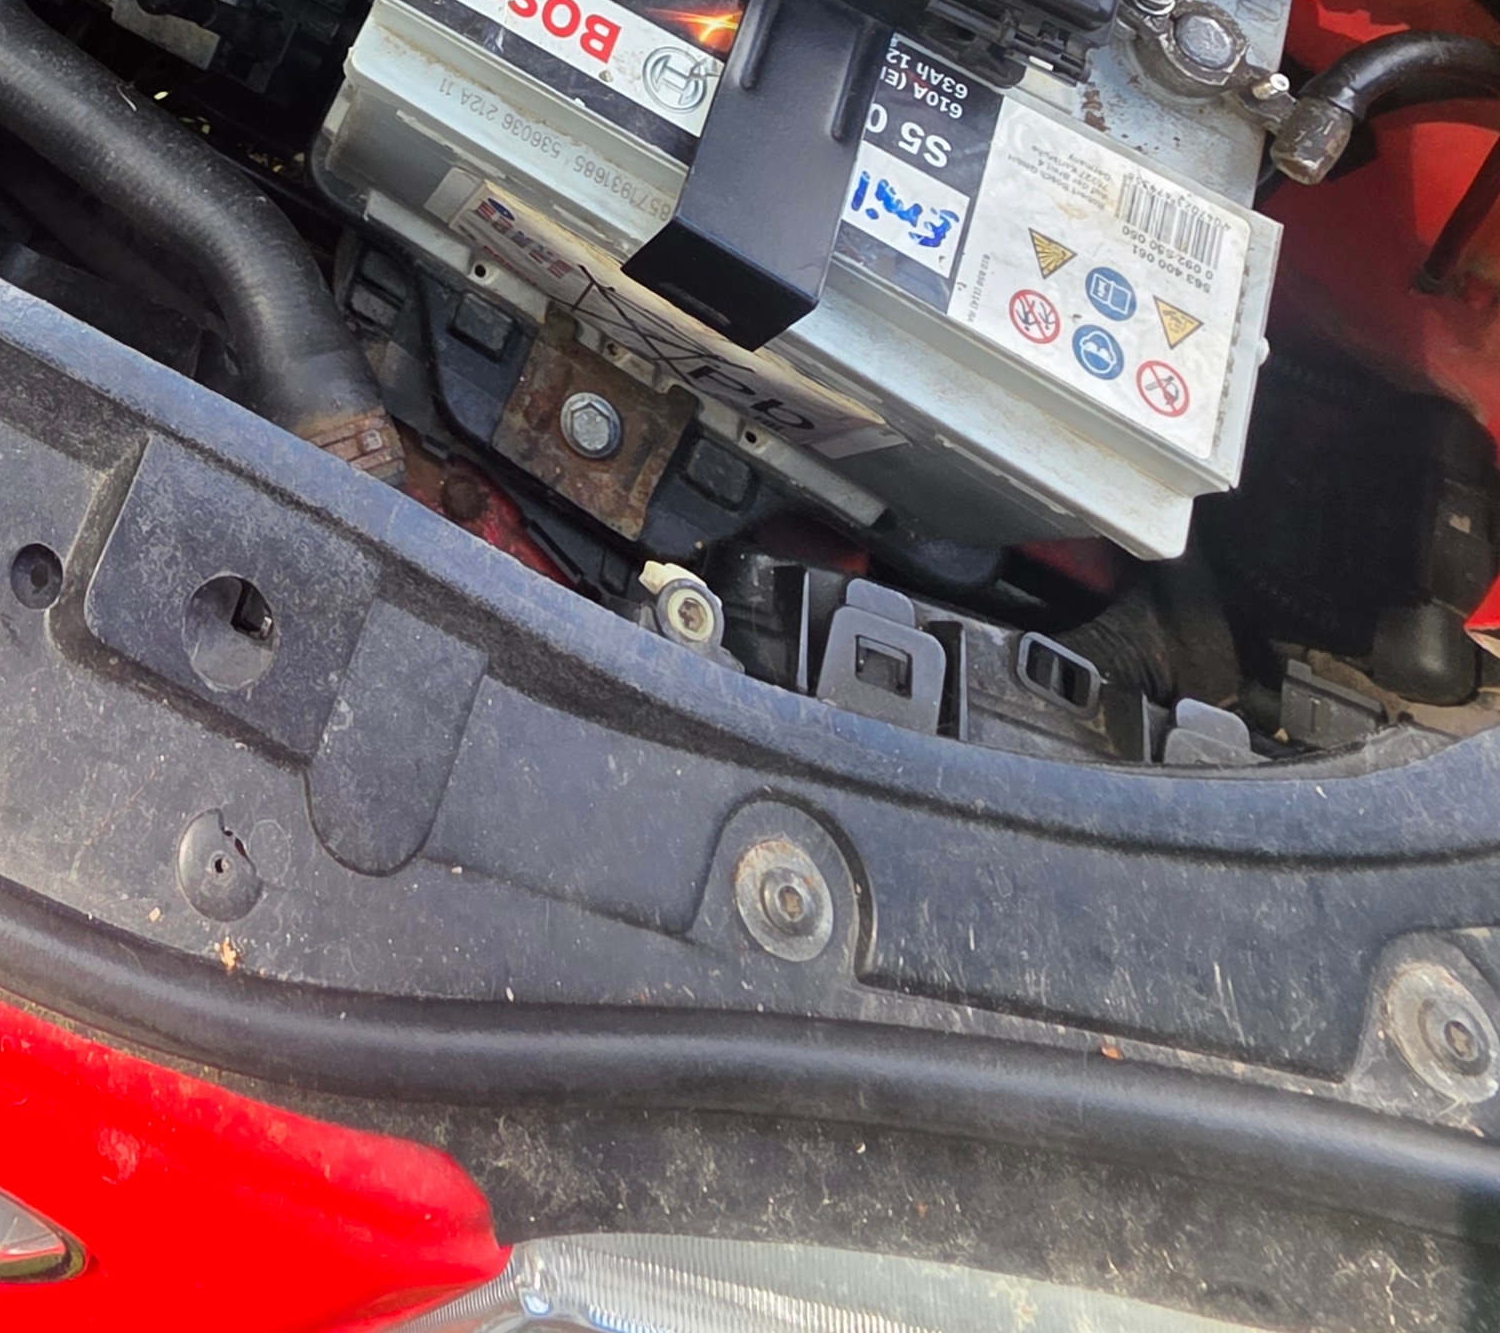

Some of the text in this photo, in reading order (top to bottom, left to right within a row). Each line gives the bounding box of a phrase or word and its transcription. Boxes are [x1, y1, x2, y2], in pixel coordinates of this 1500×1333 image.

[909, 81, 964, 119] 610A
[913, 60, 969, 100] 63Ah
[457, 86, 499, 120] 212A
[499, 111, 564, 159] 536036
[894, 123, 953, 166] S5
[686, 364, 816, 429] Pb
